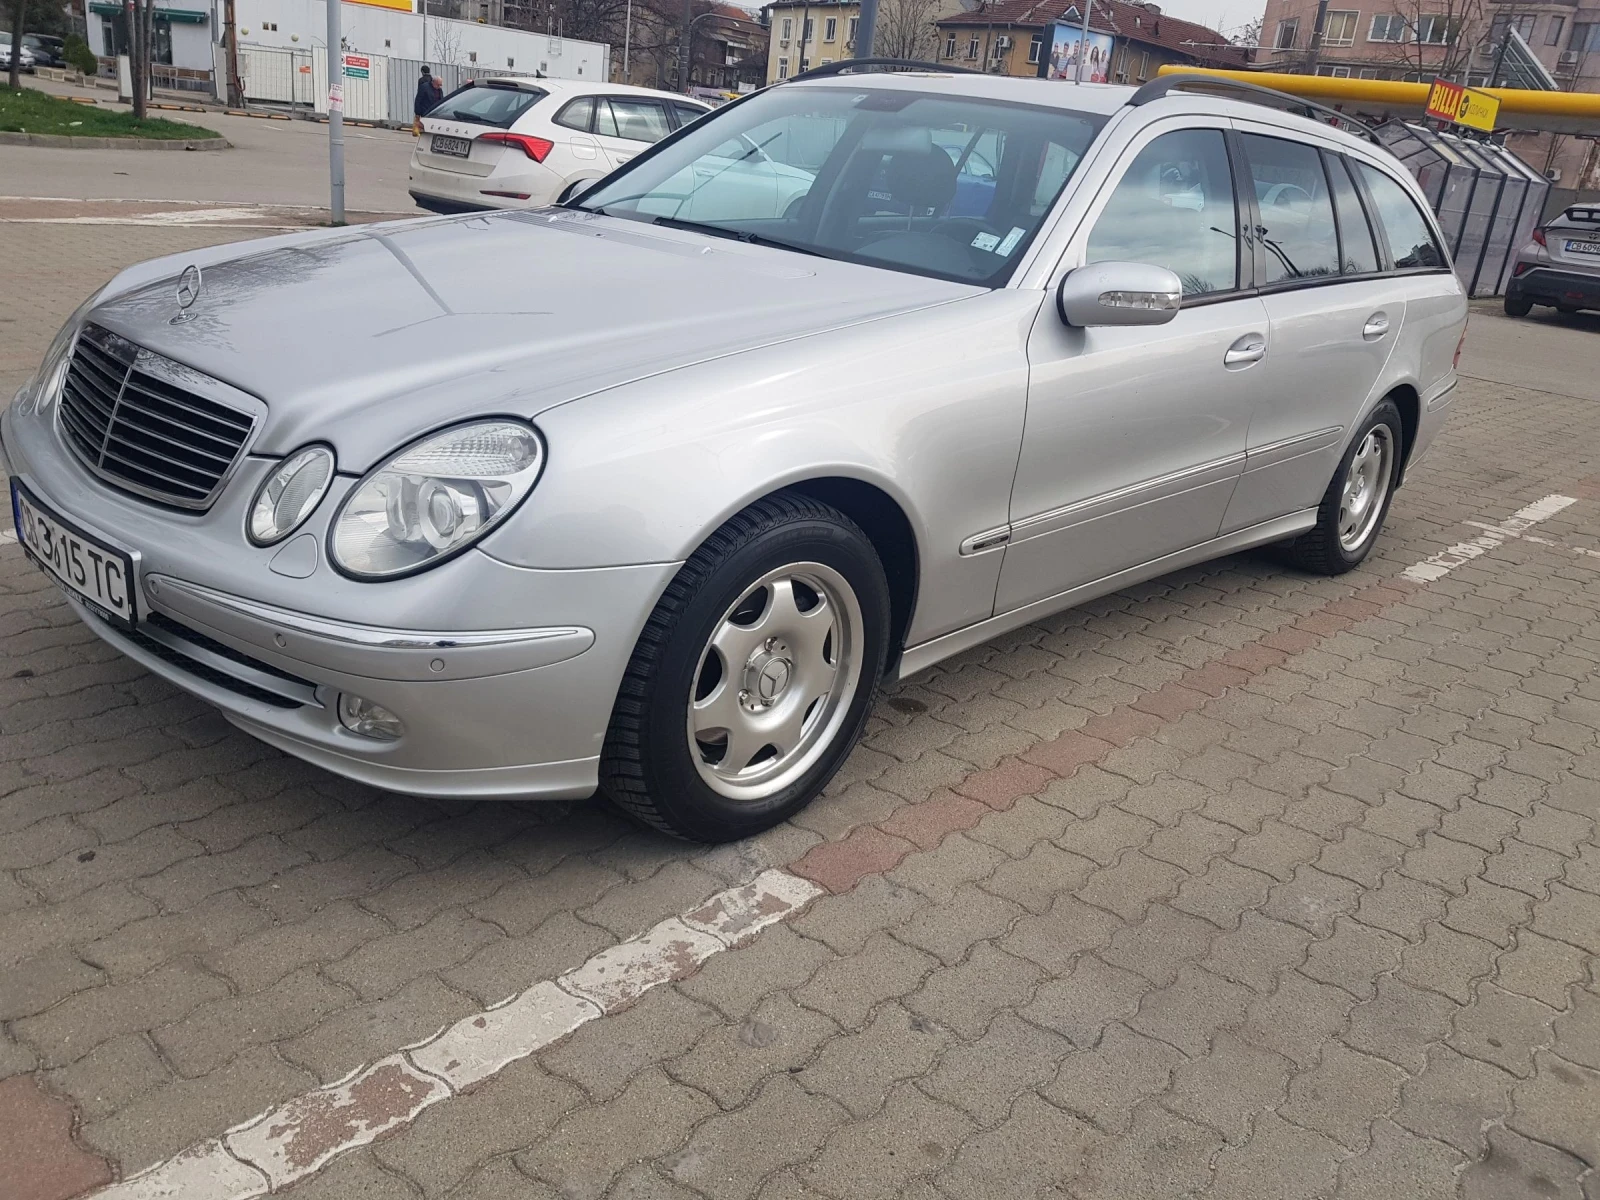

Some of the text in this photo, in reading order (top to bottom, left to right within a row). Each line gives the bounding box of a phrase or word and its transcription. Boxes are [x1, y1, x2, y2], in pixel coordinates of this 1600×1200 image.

[1429, 84, 1460, 116] BILLA
[1572, 242, 1581, 250] CB
[87, 549, 123, 609] TC
